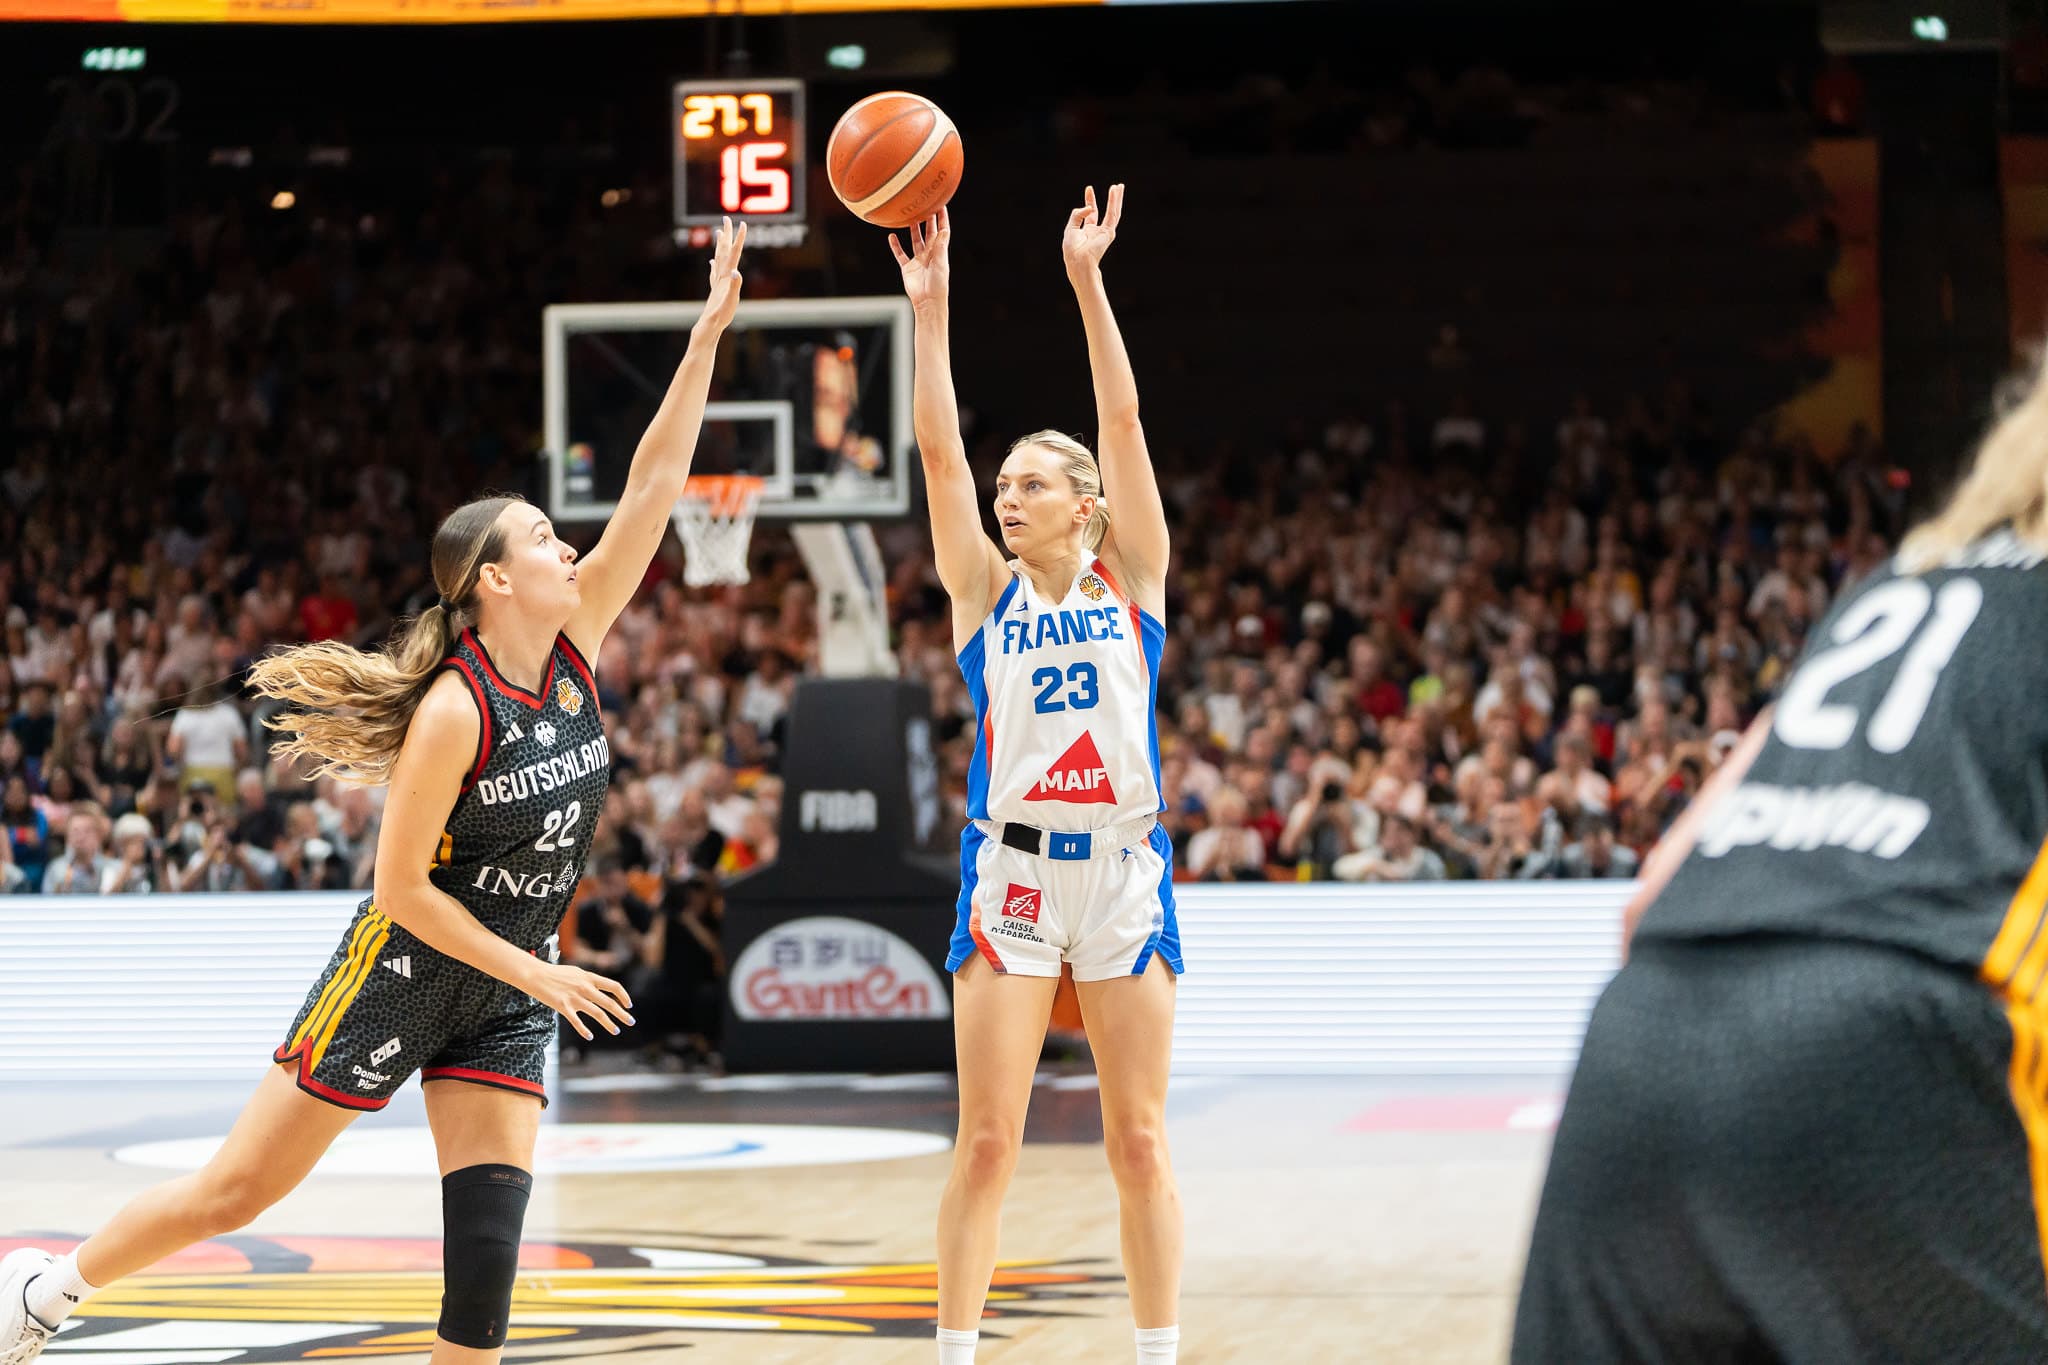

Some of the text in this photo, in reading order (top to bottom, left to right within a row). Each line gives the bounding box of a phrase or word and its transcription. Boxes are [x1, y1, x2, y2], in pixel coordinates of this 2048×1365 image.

[682, 93, 773, 139] 27.7
[721, 142, 790, 214] 15
[900, 169, 947, 216] molten
[1031, 661, 1100, 715] 23
[1775, 575, 1983, 754] 21
[478, 735, 609, 805] DEUTSCHLAND
[1039, 767, 1108, 794] MAIF
[534, 800, 582, 852] 22
[800, 789, 878, 832] FIBA
[471, 865, 552, 899] ING
[1003, 920, 1036, 934] CAISSE
